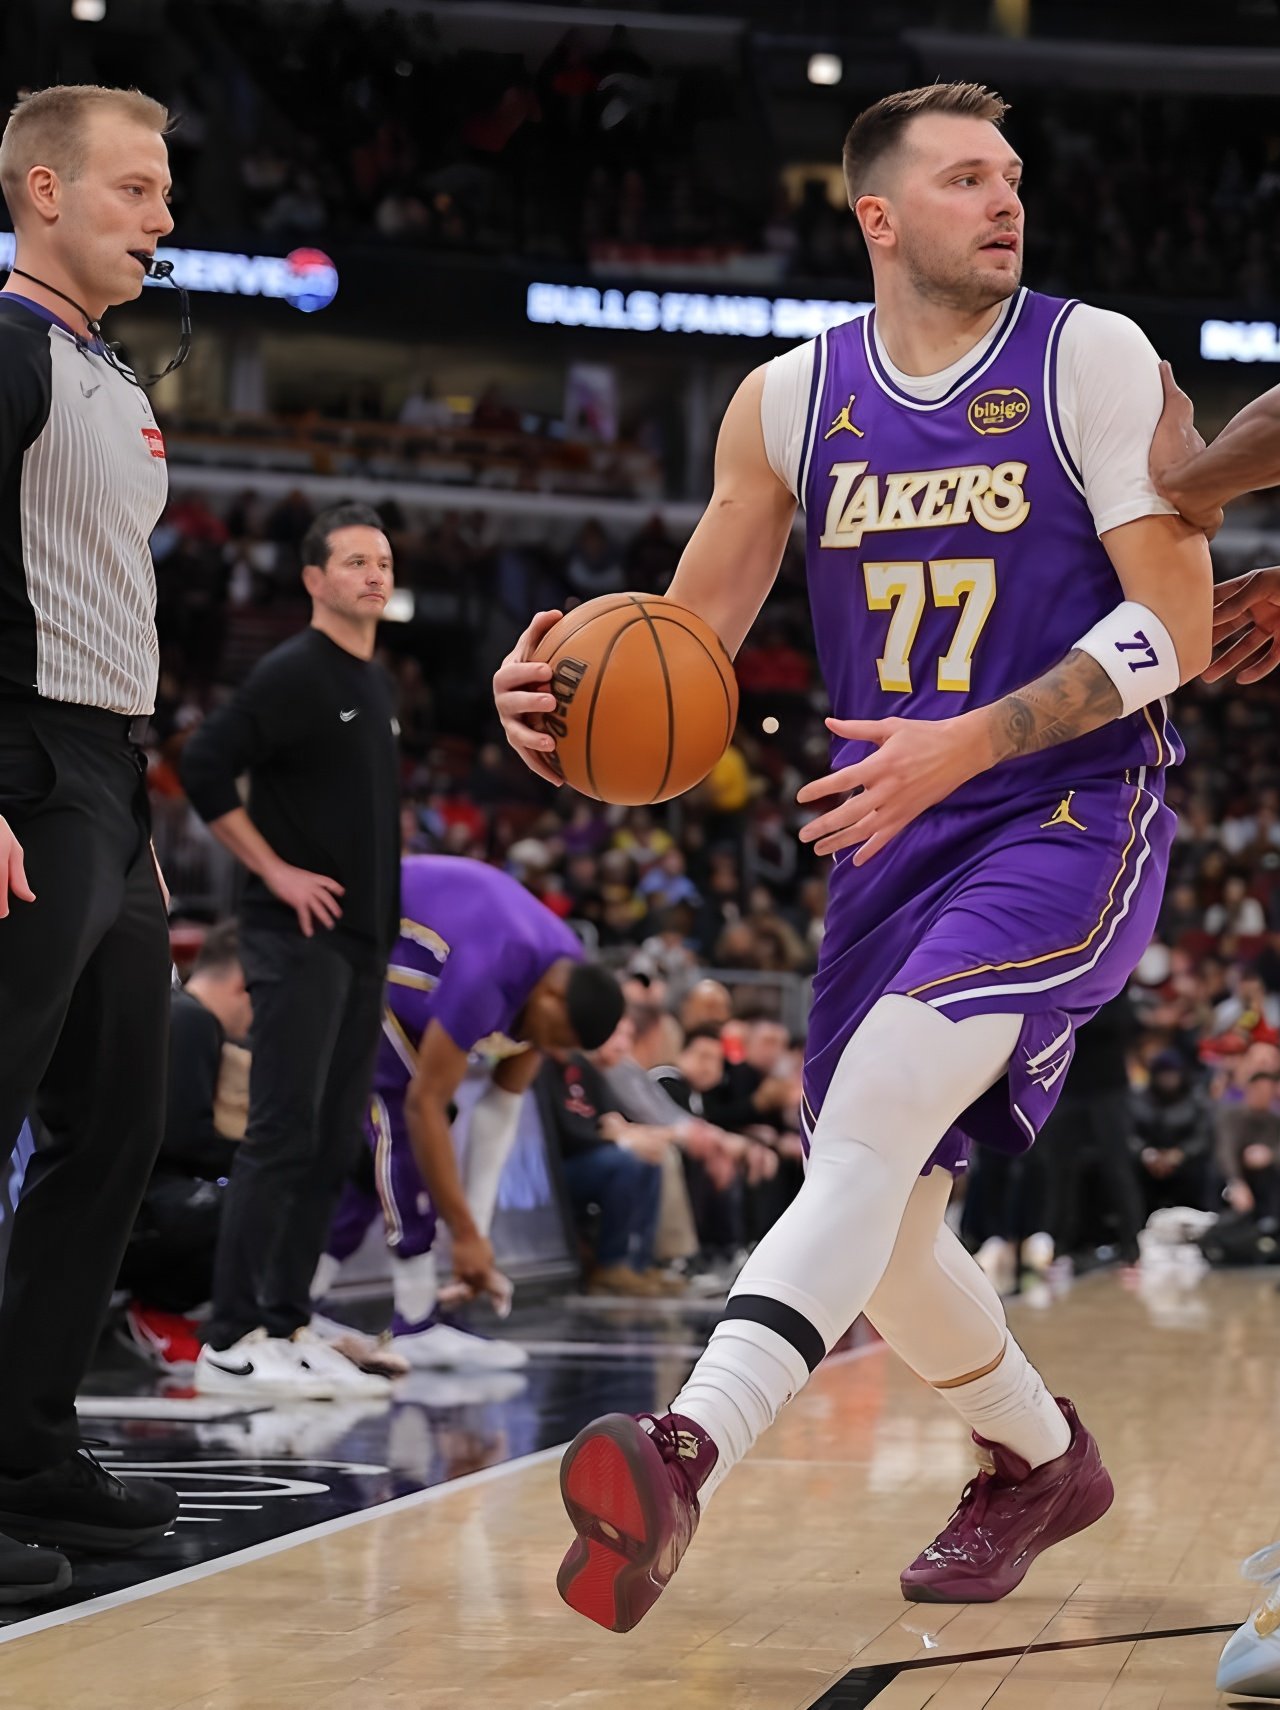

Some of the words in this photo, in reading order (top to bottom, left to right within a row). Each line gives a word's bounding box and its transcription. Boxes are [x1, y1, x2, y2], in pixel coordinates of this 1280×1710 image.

[526, 282, 661, 332] BULLS
[660, 291, 773, 338] FANS
[973, 400, 1027, 419] bibigo
[819, 460, 1031, 549] LAKERS
[862, 557, 997, 693] 77
[1114, 629, 1160, 673] 77
